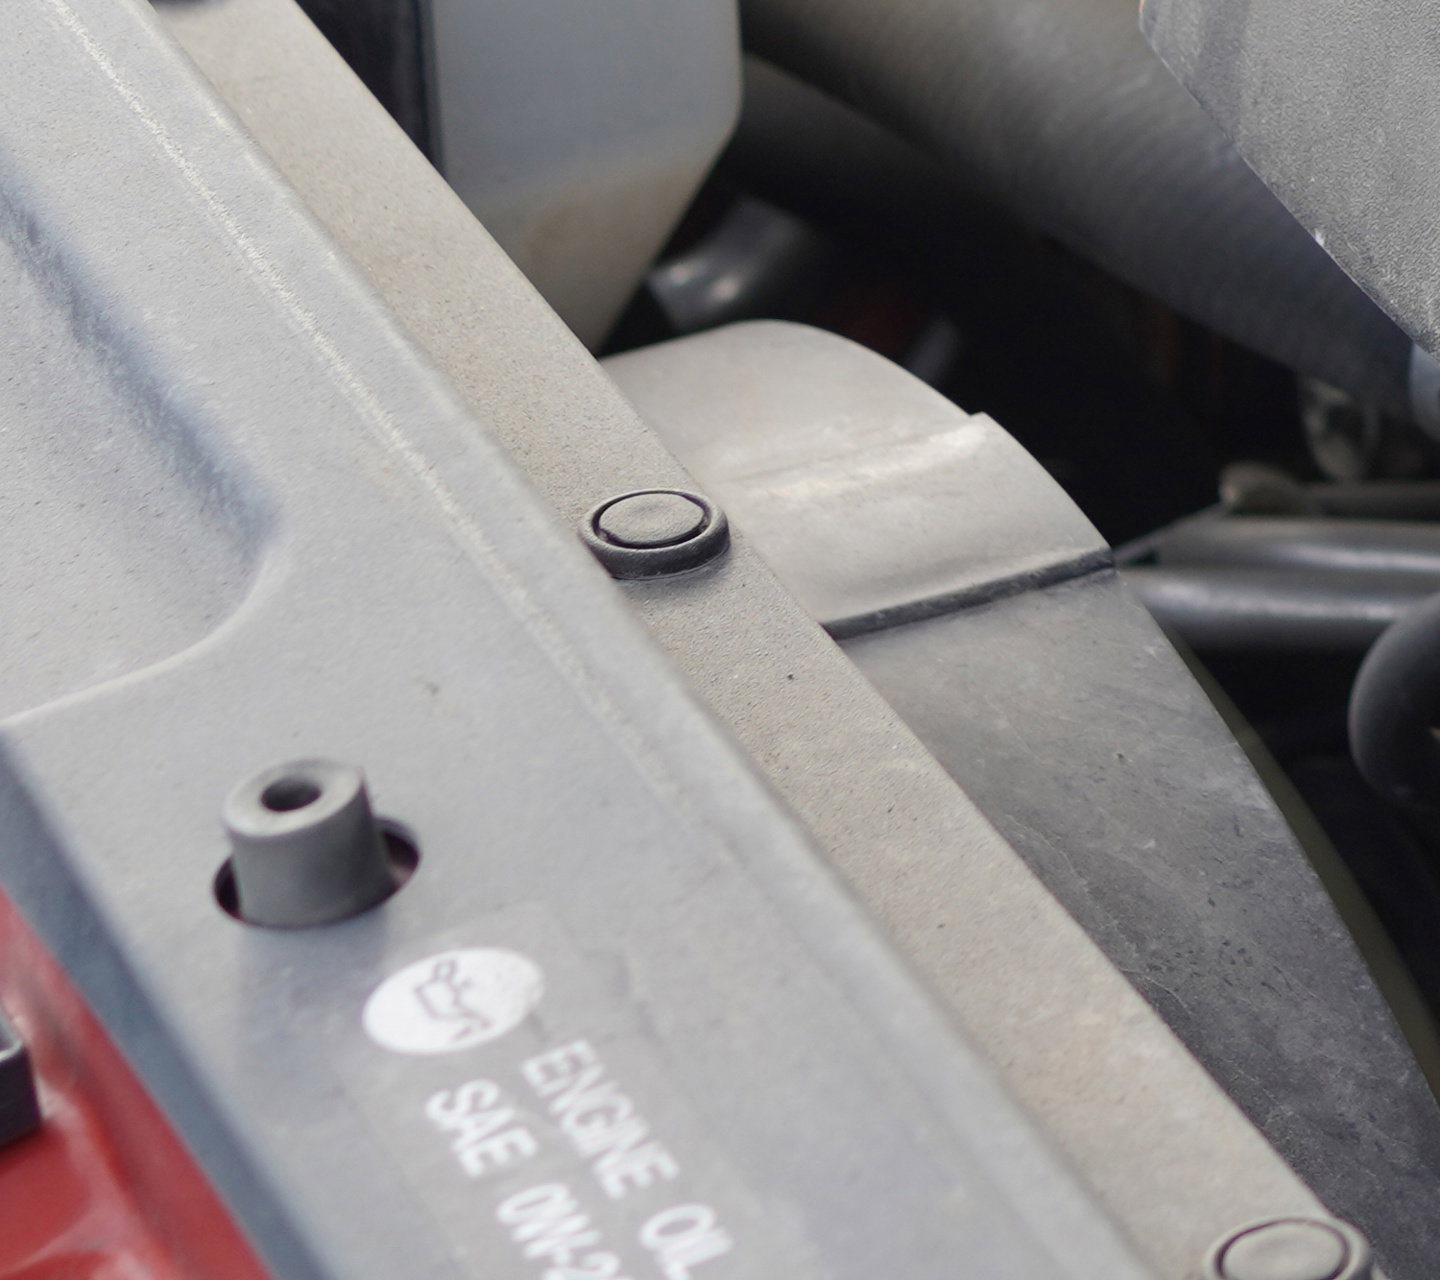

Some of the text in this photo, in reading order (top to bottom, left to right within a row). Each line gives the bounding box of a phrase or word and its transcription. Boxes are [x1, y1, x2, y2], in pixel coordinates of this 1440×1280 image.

[424, 1078, 635, 1280] SAE 0W-2
[520, 1039, 732, 1280] ENGINE OIL
